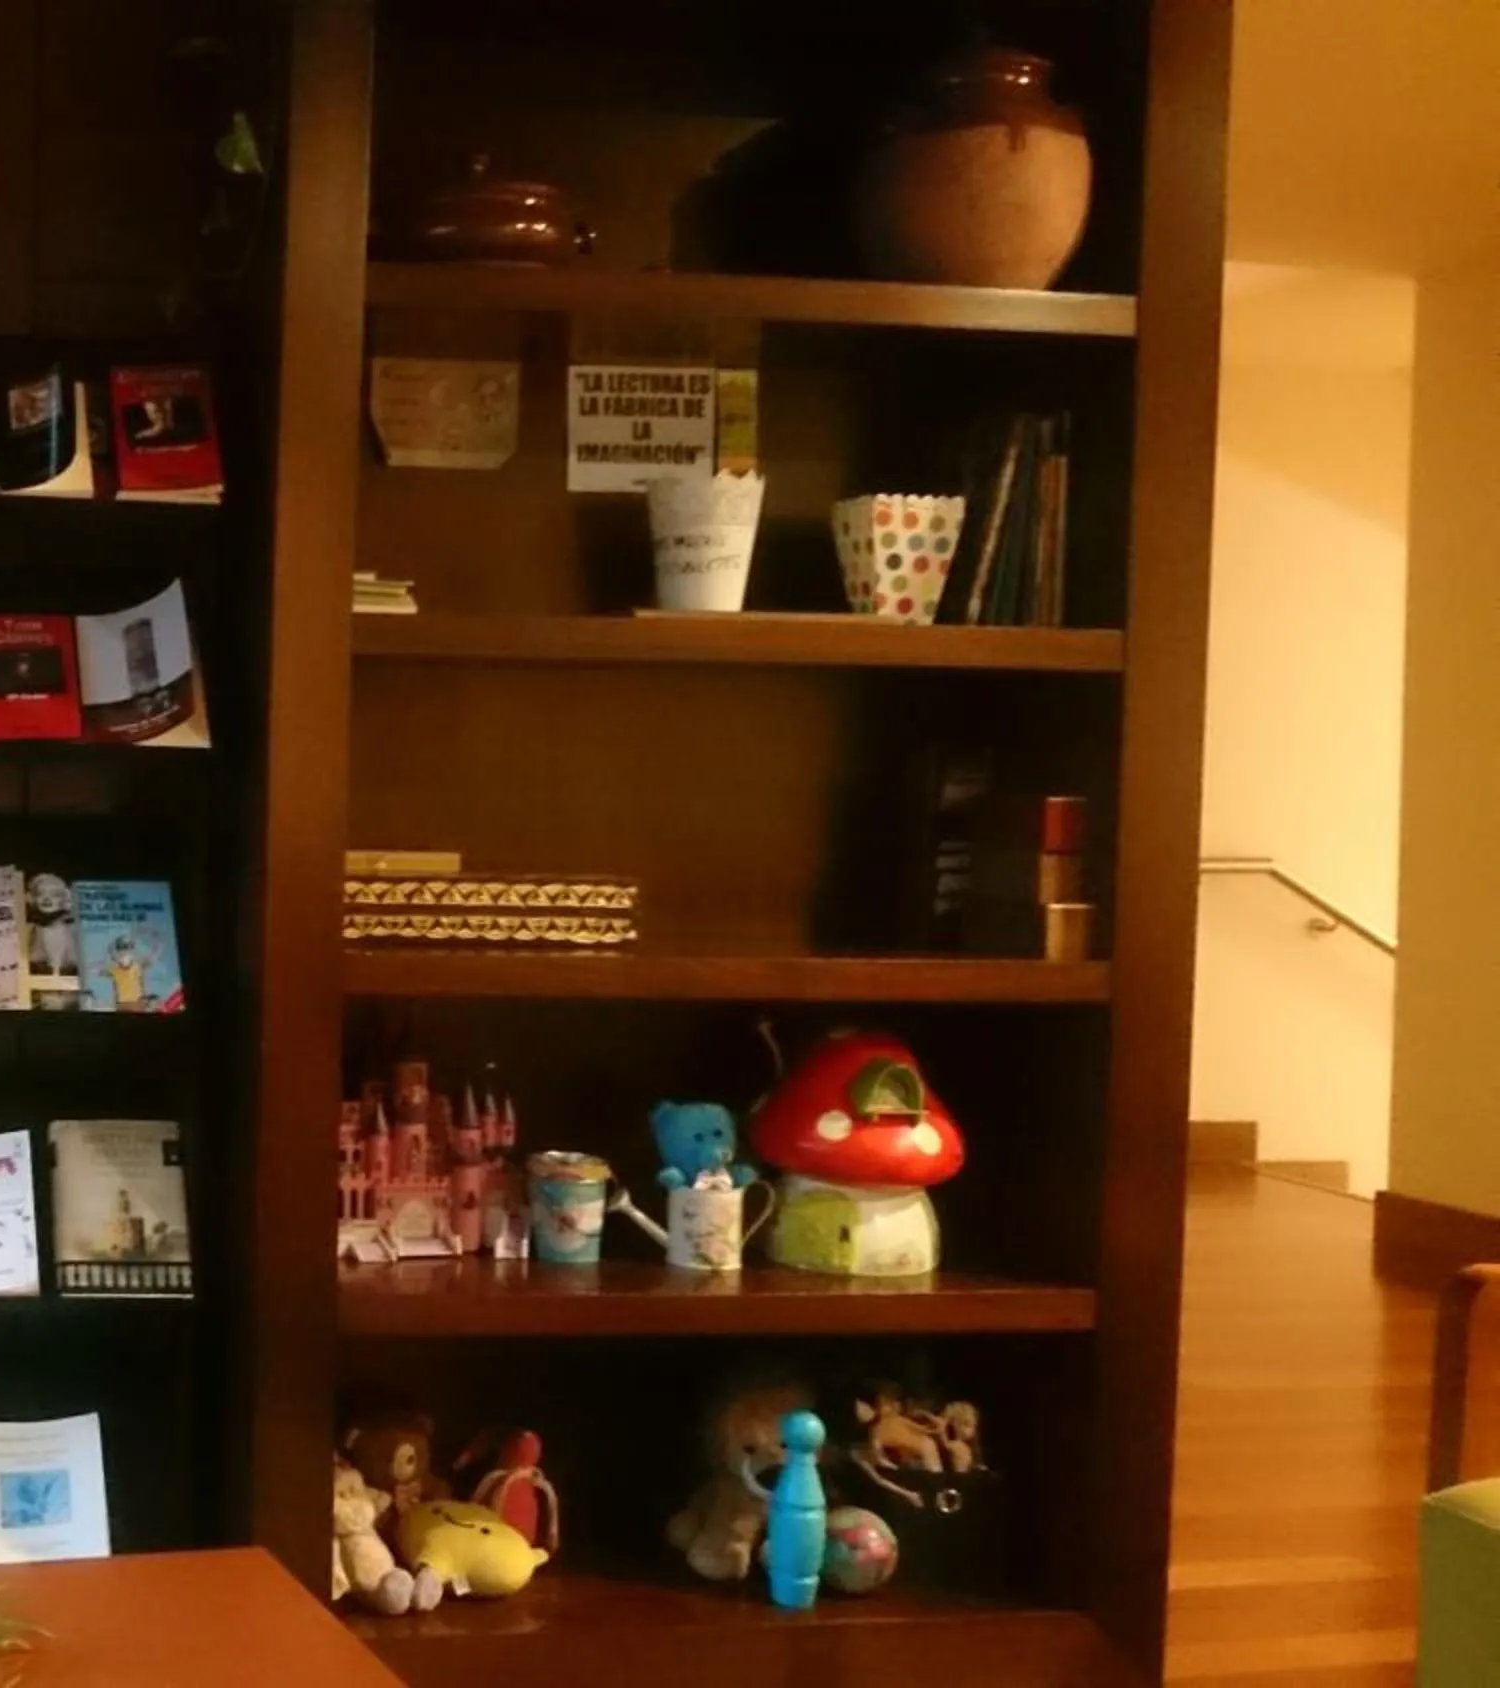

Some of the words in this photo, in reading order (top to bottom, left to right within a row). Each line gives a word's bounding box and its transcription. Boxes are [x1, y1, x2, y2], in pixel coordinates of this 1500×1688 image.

[608, 373, 685, 394] LECTURA
[688, 374, 711, 395] ES
[579, 397, 601, 417] LA
[603, 395, 680, 417] FÁBRICA
[683, 397, 706, 417] DE
[631, 421, 653, 441] LA
